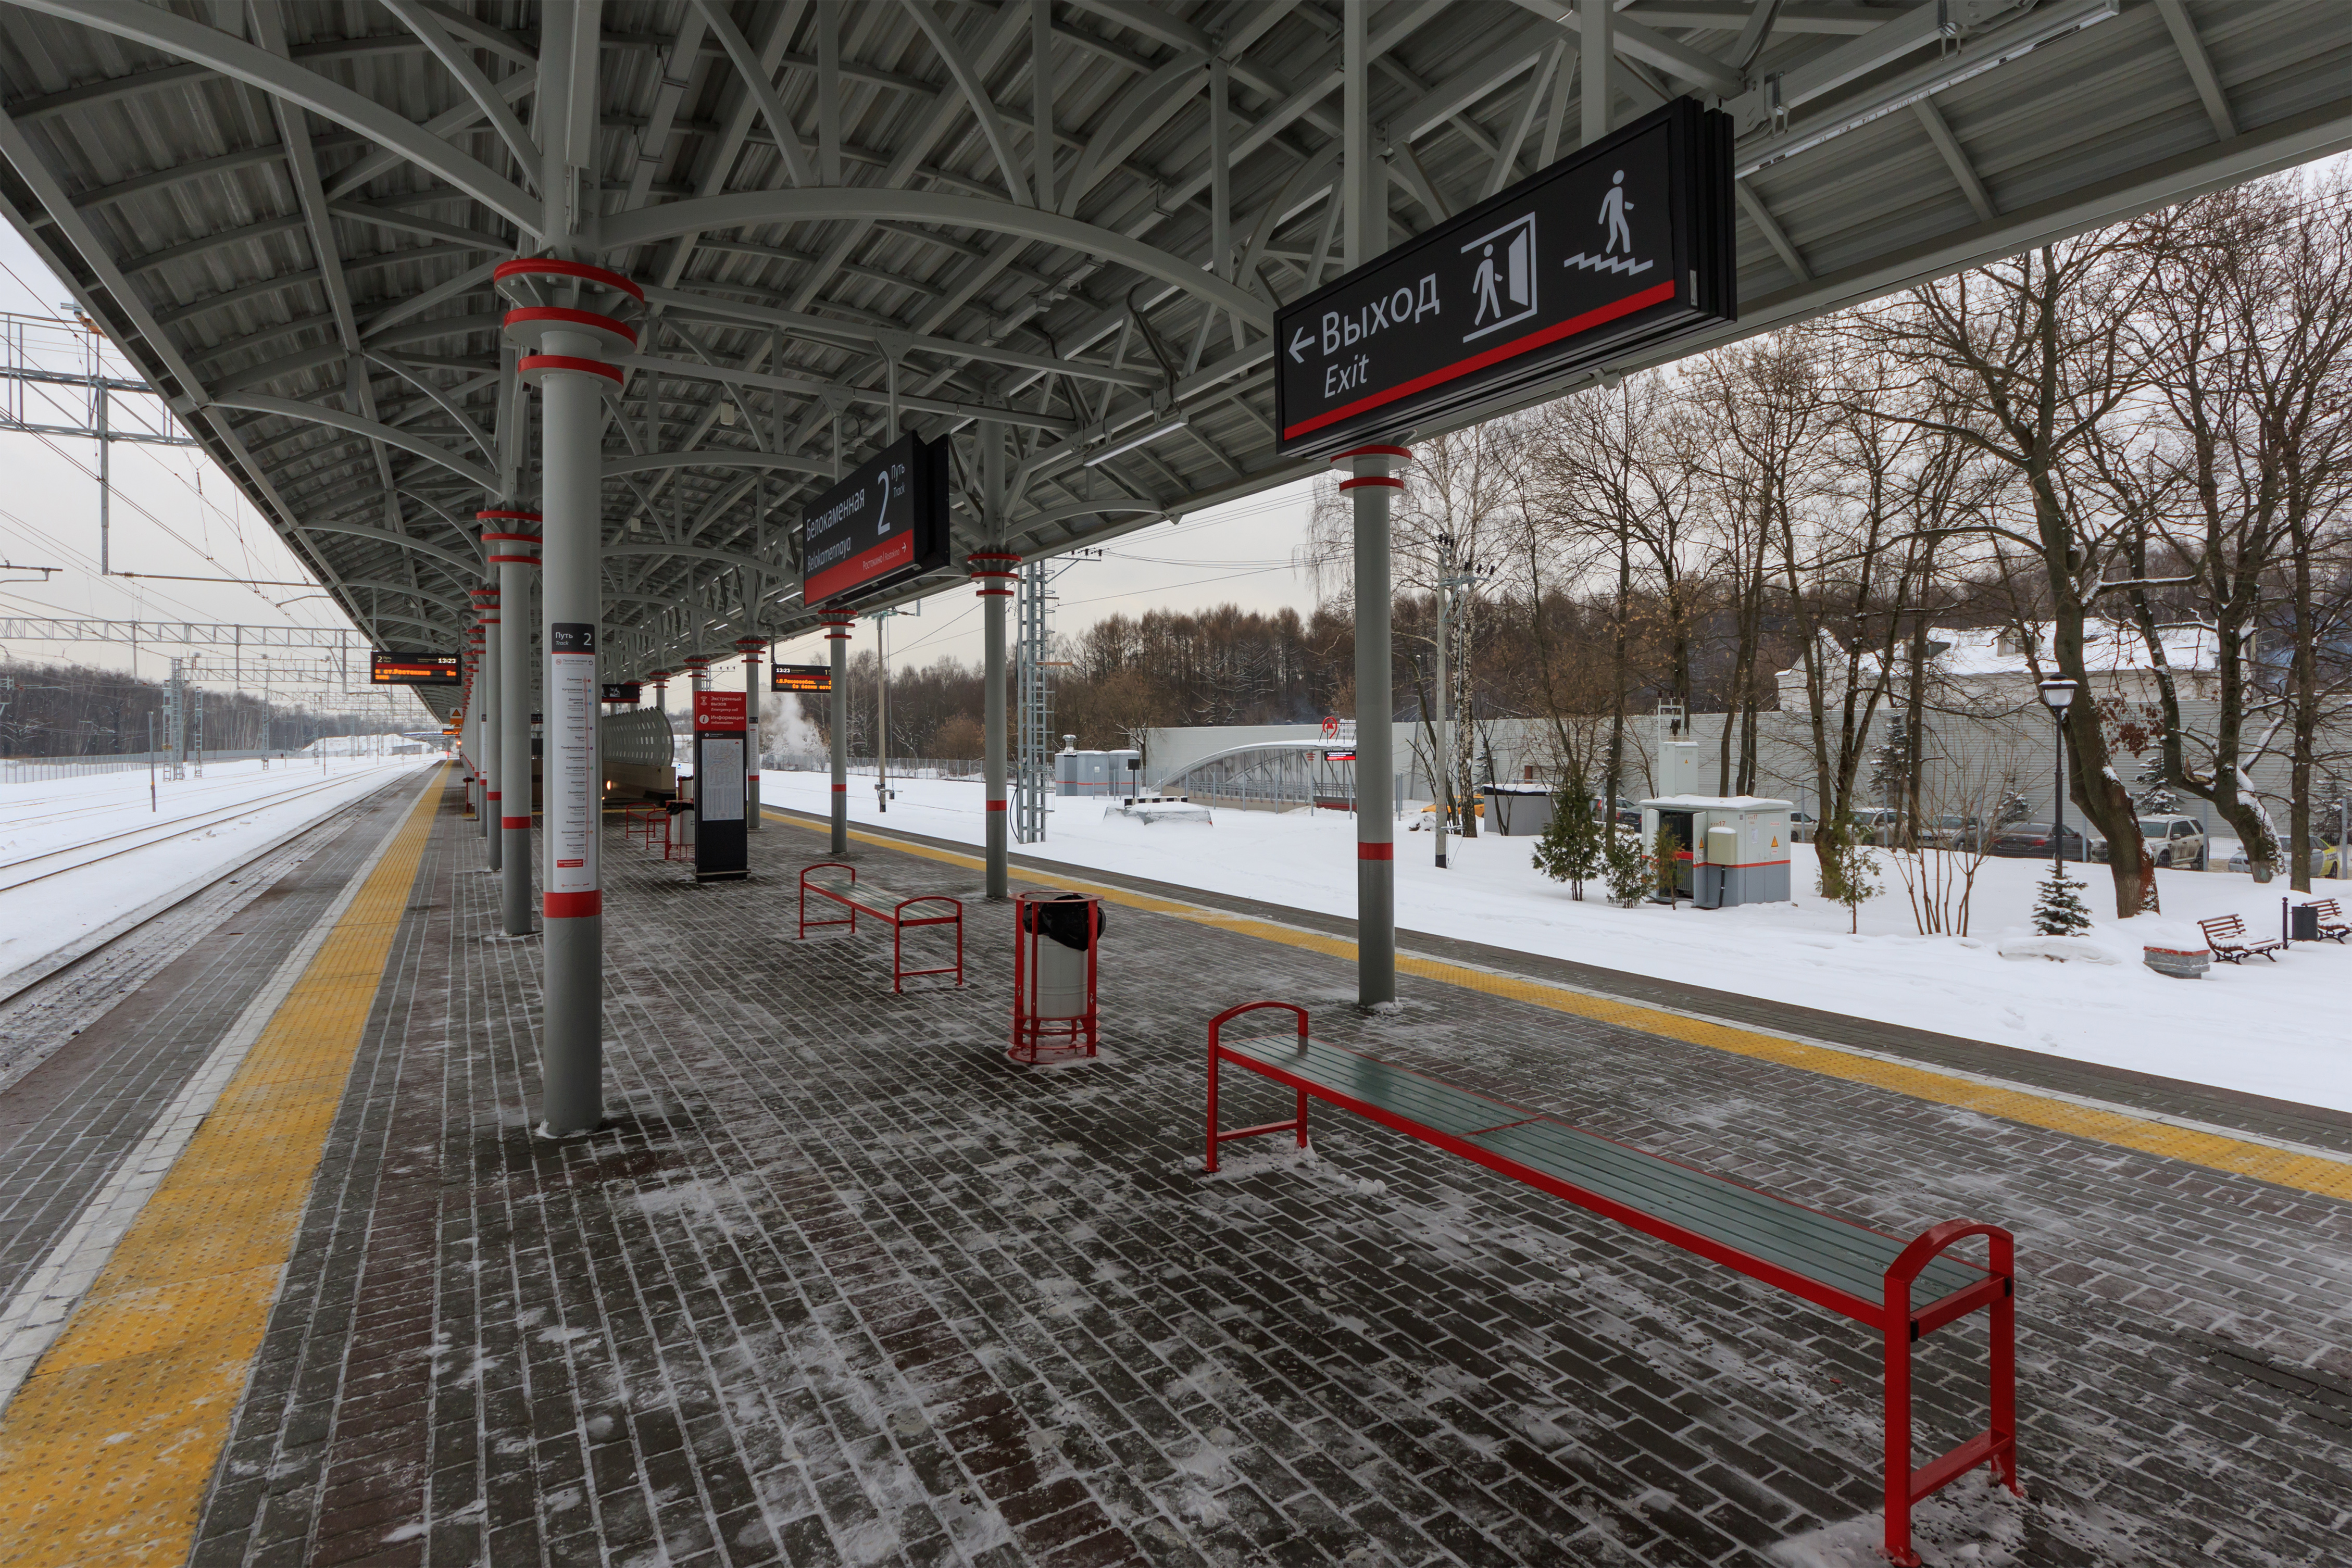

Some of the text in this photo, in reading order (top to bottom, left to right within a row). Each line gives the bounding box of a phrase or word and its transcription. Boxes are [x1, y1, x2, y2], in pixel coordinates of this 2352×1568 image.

[1322, 273, 1441, 356] Выход
[1324, 353, 1370, 399] Exit
[891, 463, 905, 482] Путь
[893, 482, 905, 498] Track
[807, 488, 865, 542] Белокаменная
[878, 470, 891, 536] 2
[807, 536, 851, 572] Belokamennaya
[555, 632, 592, 646] Путь 2
